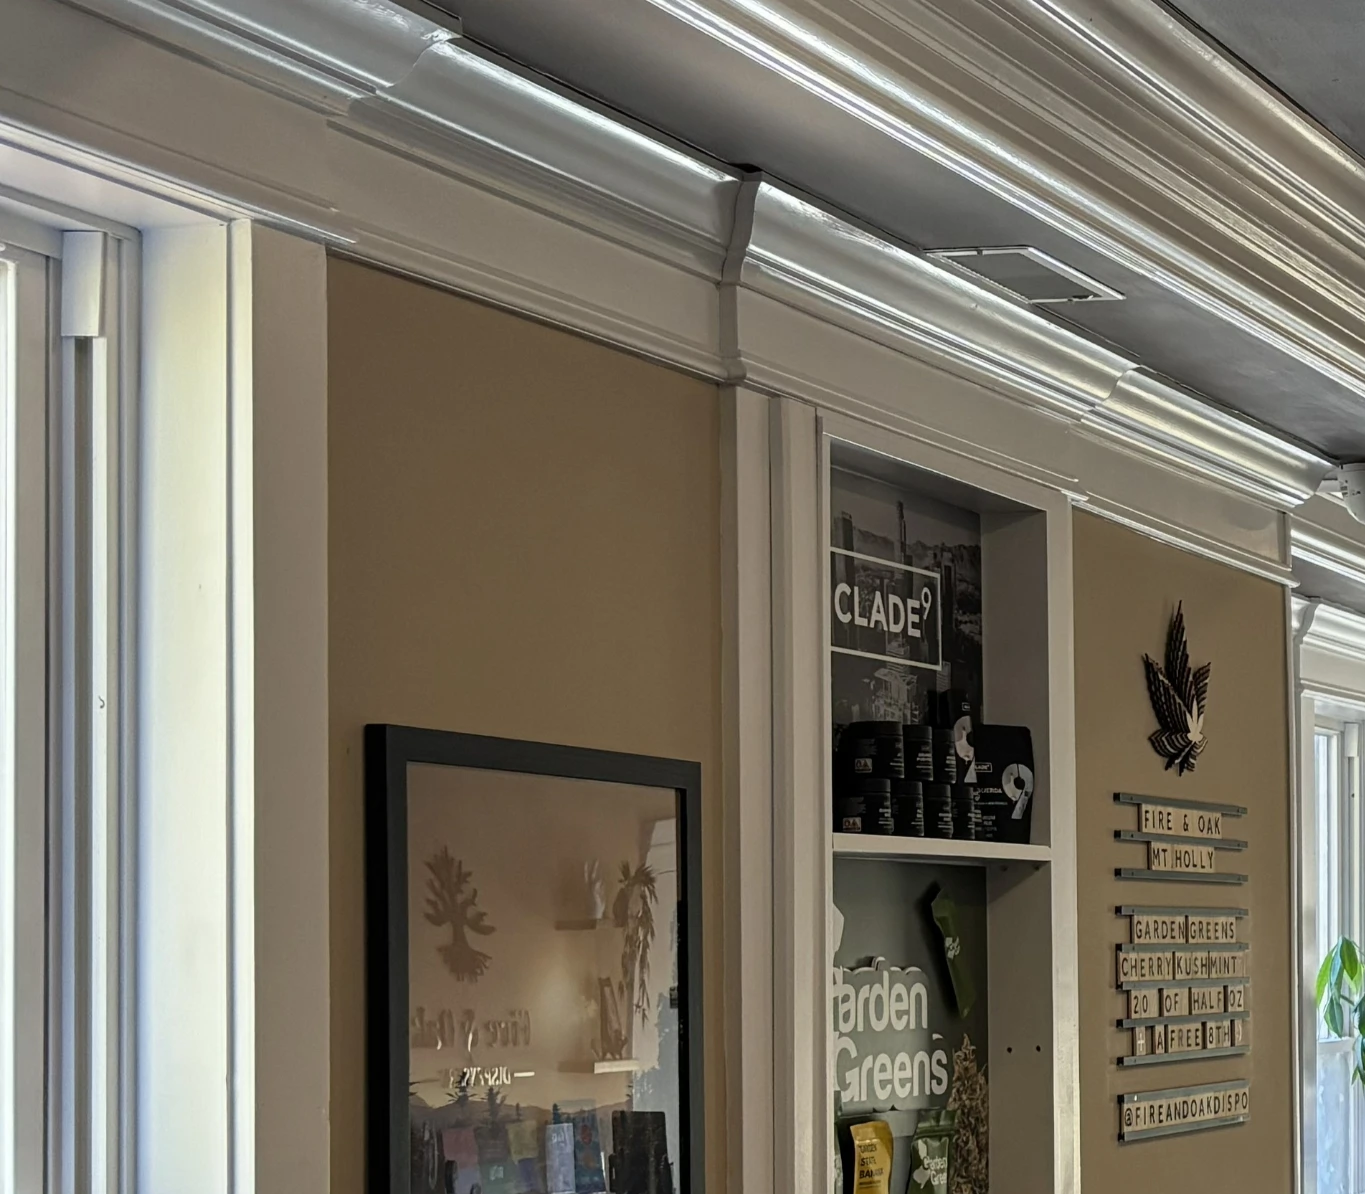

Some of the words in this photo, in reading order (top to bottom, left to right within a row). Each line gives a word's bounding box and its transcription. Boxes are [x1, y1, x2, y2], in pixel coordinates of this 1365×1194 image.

[1144, 809, 1173, 831] FIRE
[1182, 813, 1189, 831] &
[1198, 815, 1221, 836] OAK
[1152, 847, 1168, 868] MT
[1174, 848, 1214, 870] HOLLY
[1135, 918, 1186, 941] GARDEN
[1189, 919, 1236, 941] GREENS
[1121, 956, 1171, 977] CHERRY
[1176, 956, 1208, 976] KUSH
[833, 970, 928, 1034] arden
[1133, 994, 1149, 1014] 20
[1164, 993, 1179, 1013] OF
[1193, 990, 1222, 1010] HALF
[1229, 990, 1242, 1007] OZ
[1157, 1031, 1164, 1050] A
[1170, 1027, 1201, 1048] FREE
[1208, 1025, 1230, 1045] 8TH
[833, 1035, 948, 1102] Greens
[1124, 1091, 1249, 1128] @FIREANDOAKDISPO
[930, 1172, 948, 1186] Gree
